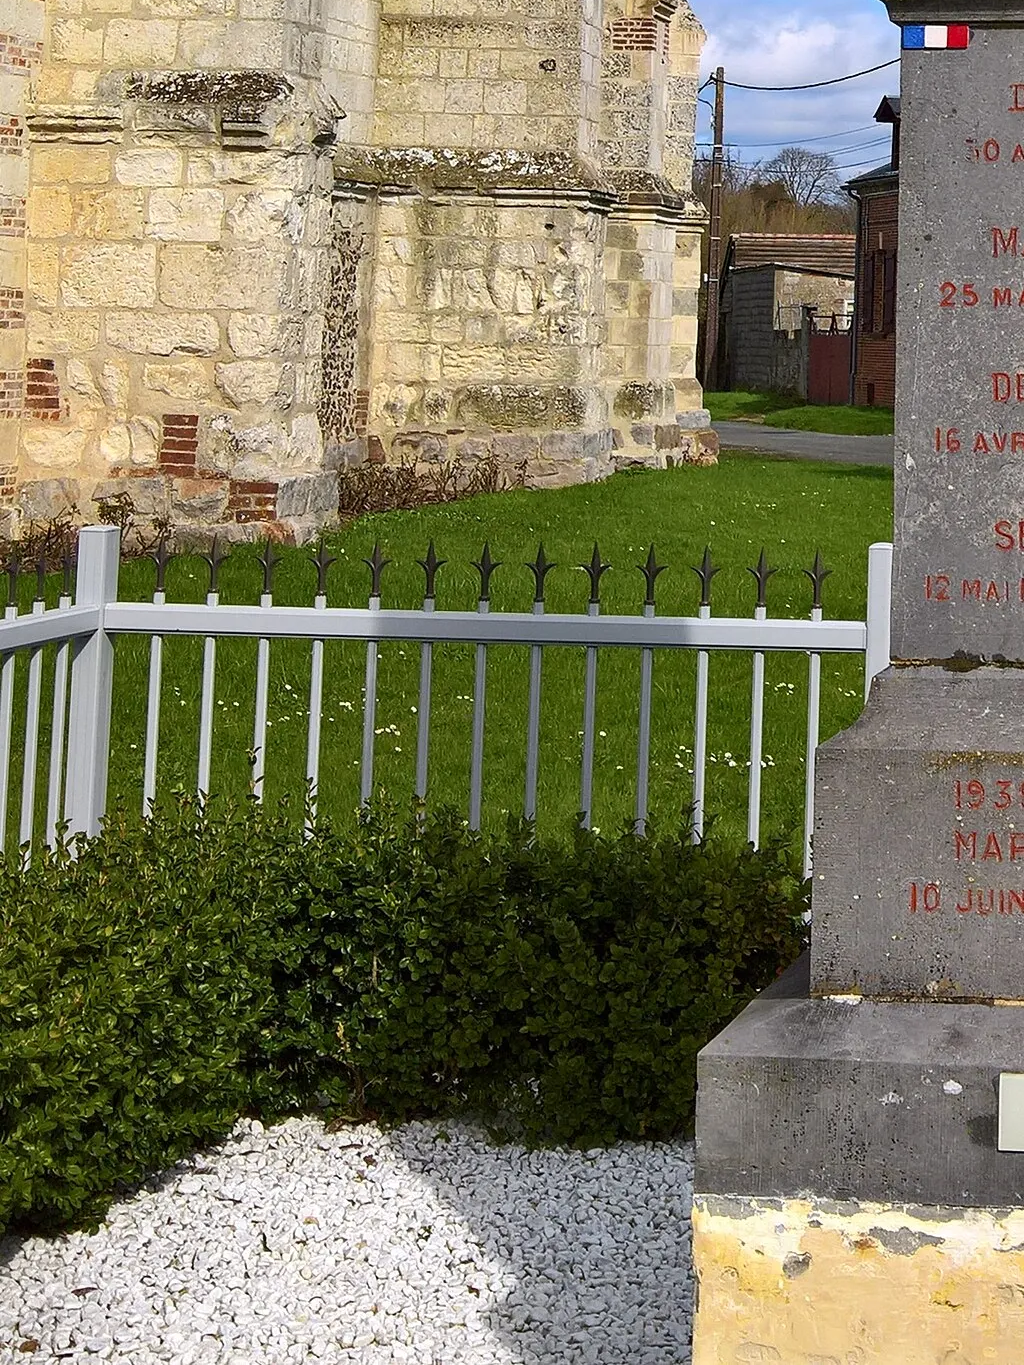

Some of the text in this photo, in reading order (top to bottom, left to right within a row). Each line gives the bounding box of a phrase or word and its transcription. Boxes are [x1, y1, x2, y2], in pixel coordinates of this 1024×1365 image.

[938, 280, 981, 311] 25
[934, 426, 962, 454] 16
[924, 574, 951, 603] 12
[959, 577, 1010, 602] MAI
[907, 881, 941, 915] 10
